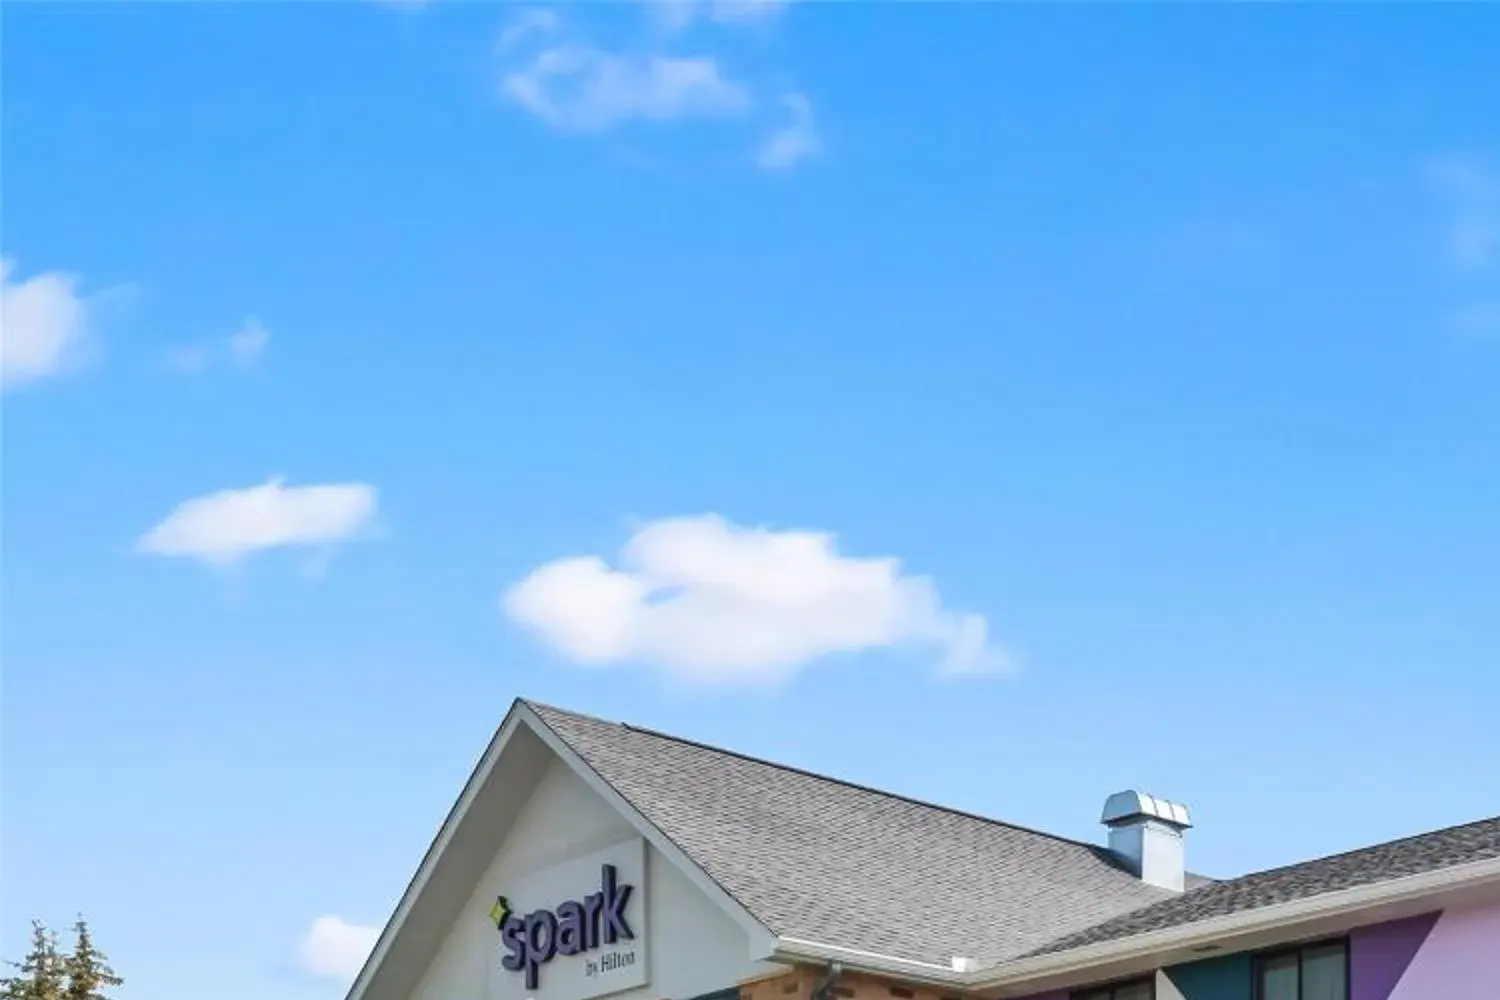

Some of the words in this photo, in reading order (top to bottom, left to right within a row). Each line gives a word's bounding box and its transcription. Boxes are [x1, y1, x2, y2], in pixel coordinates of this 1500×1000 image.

[502, 863, 635, 990] spark
[585, 959, 598, 979] by
[601, 951, 635, 973] Hilton
